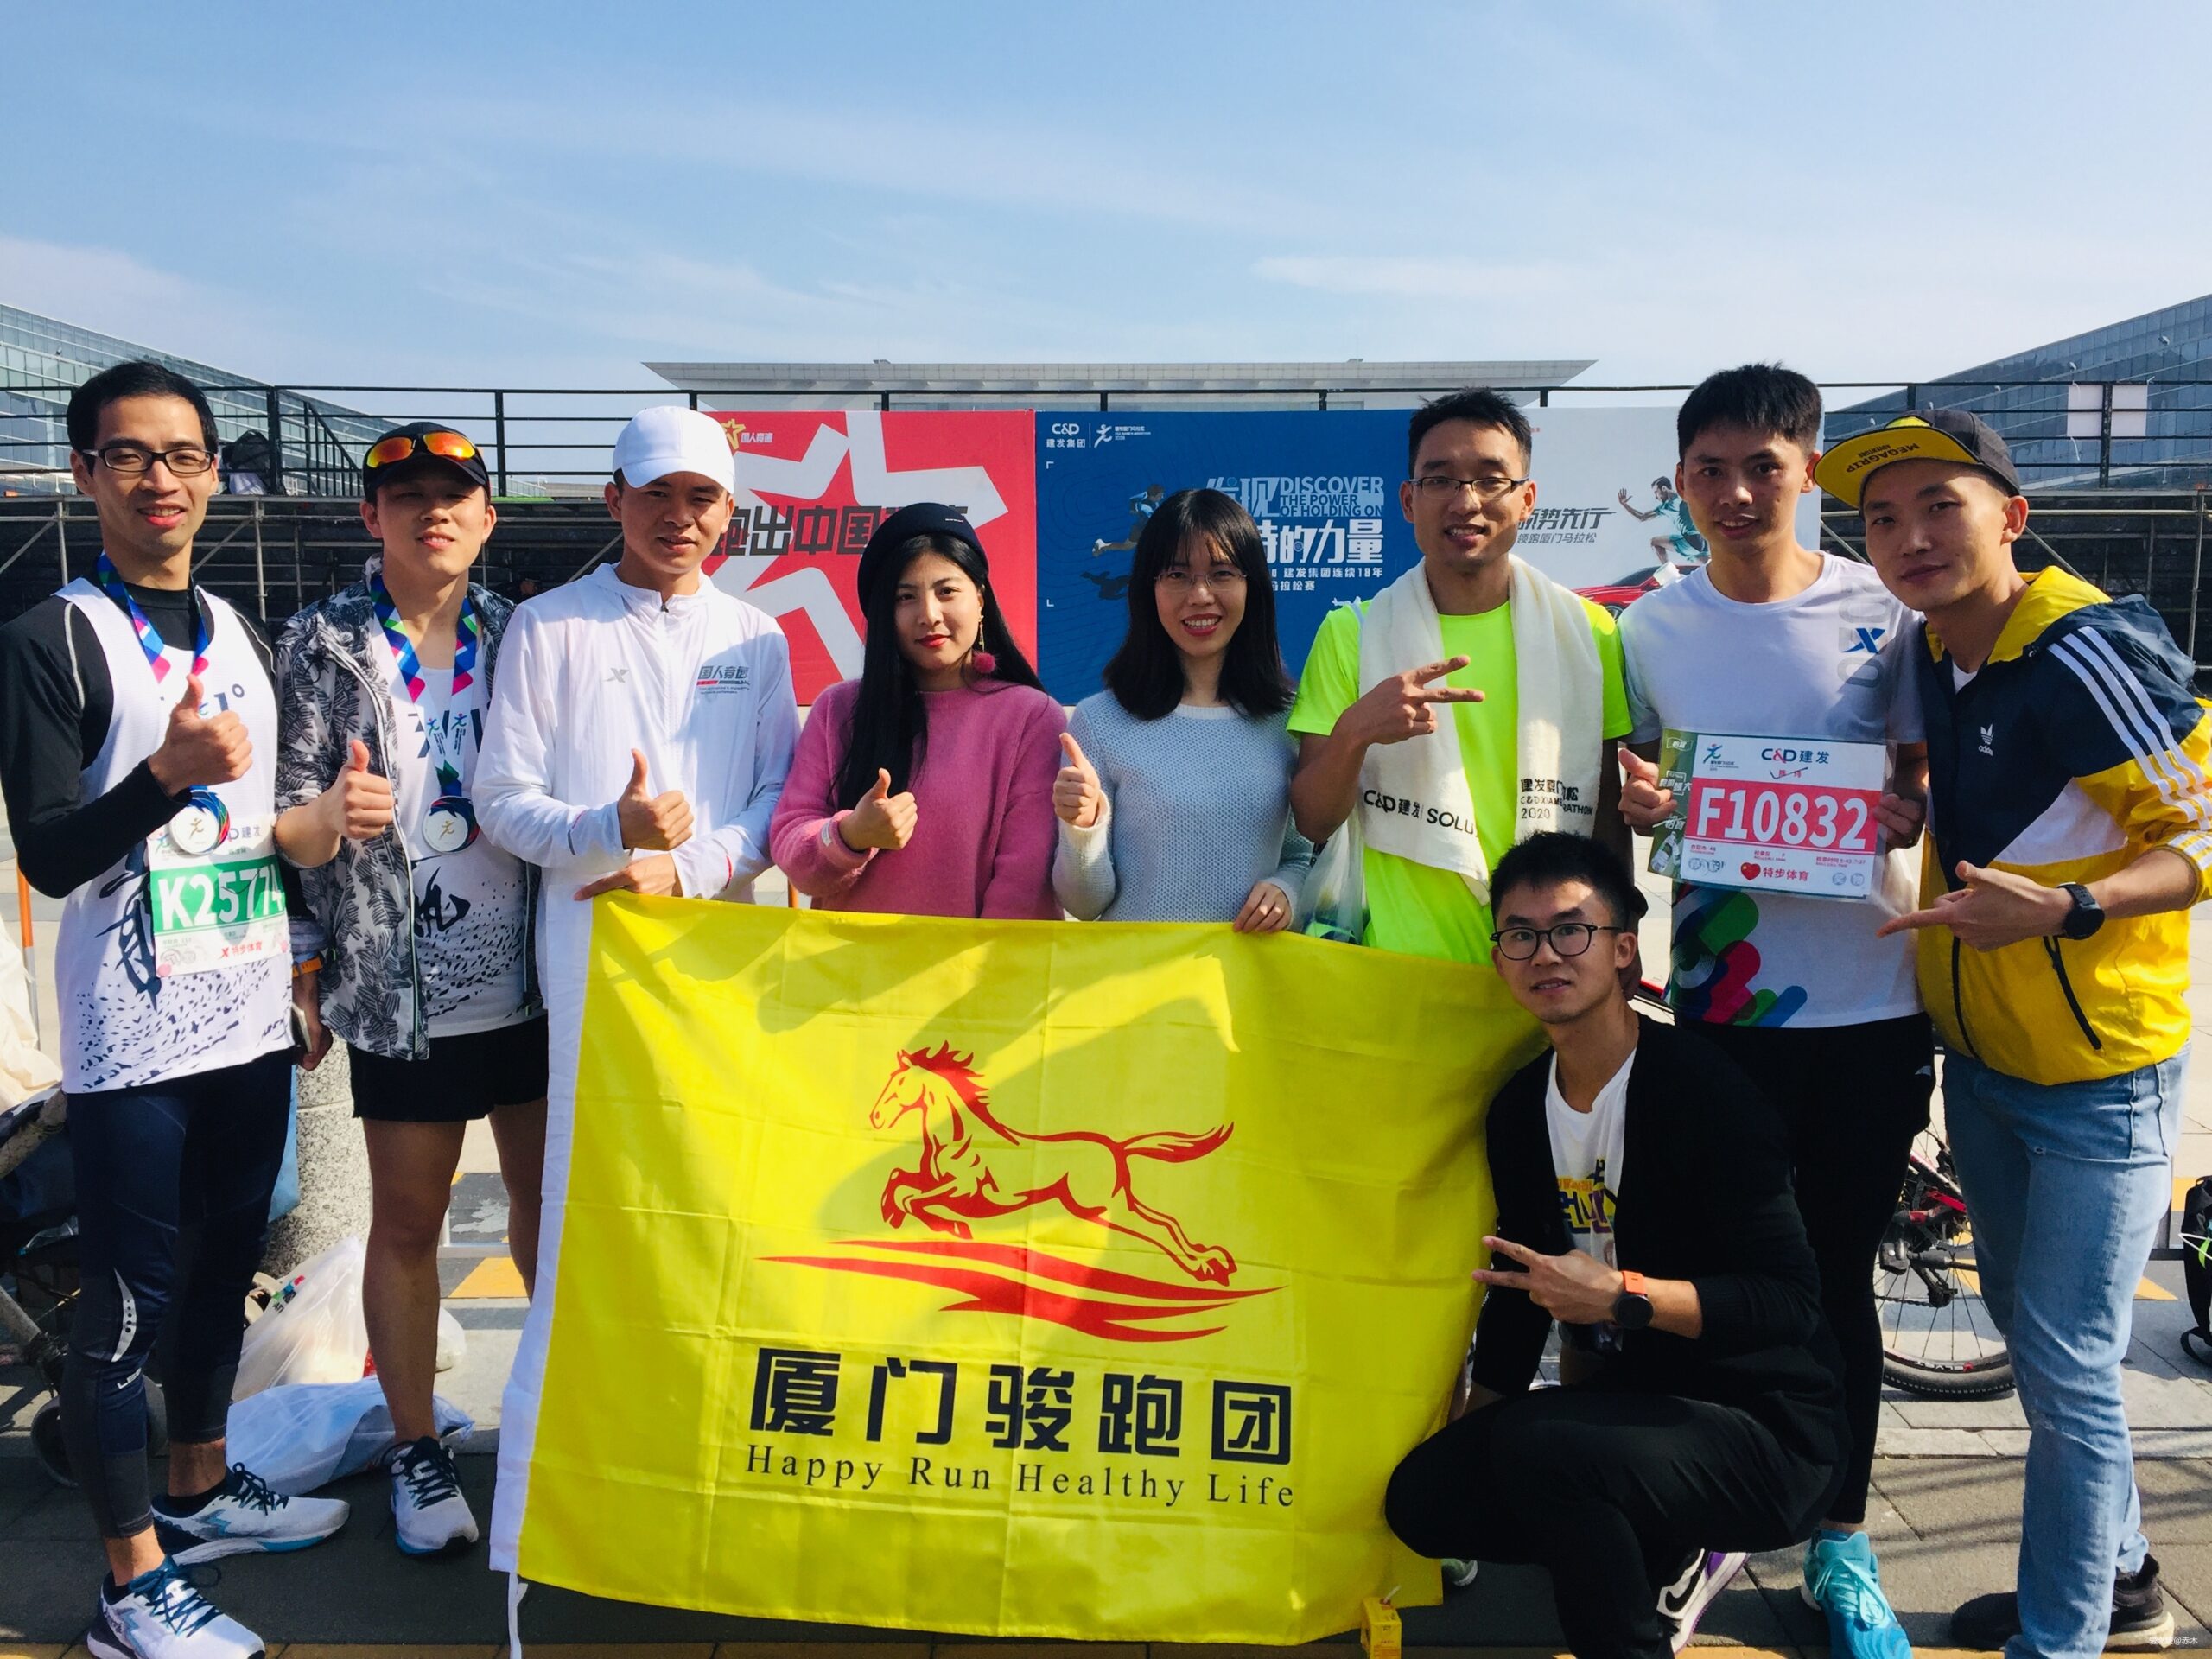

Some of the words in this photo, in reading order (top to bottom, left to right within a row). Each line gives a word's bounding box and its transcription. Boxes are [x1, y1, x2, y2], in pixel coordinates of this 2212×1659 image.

[1052, 423, 1079, 435] C&D
[1046, 438, 1085, 448] 建发集团
[1846, 442, 1920, 473] MEGAGRIP
[1281, 476, 1384, 494] DISCOVER
[1282, 494, 1306, 505] THE
[1310, 494, 1358, 506] POWER
[1280, 505, 1299, 518] OF
[1301, 505, 1361, 518] HOLDING
[1363, 505, 1382, 518] ON
[1761, 748, 1797, 764] C&D
[1799, 750, 1829, 765] 建发
[1363, 790, 1396, 813] C&D
[1521, 807, 1550, 819] 2020
[1696, 787, 1868, 850] F10832
[1763, 867, 1808, 882] 特步体育
[748, 1347, 1293, 1465] 厦门骏跑团
[746, 1445, 883, 1491] Happy
[910, 1456, 991, 1491] Run
[1018, 1464, 1185, 1508] Healthy
[1210, 1473, 1294, 1507] Life
